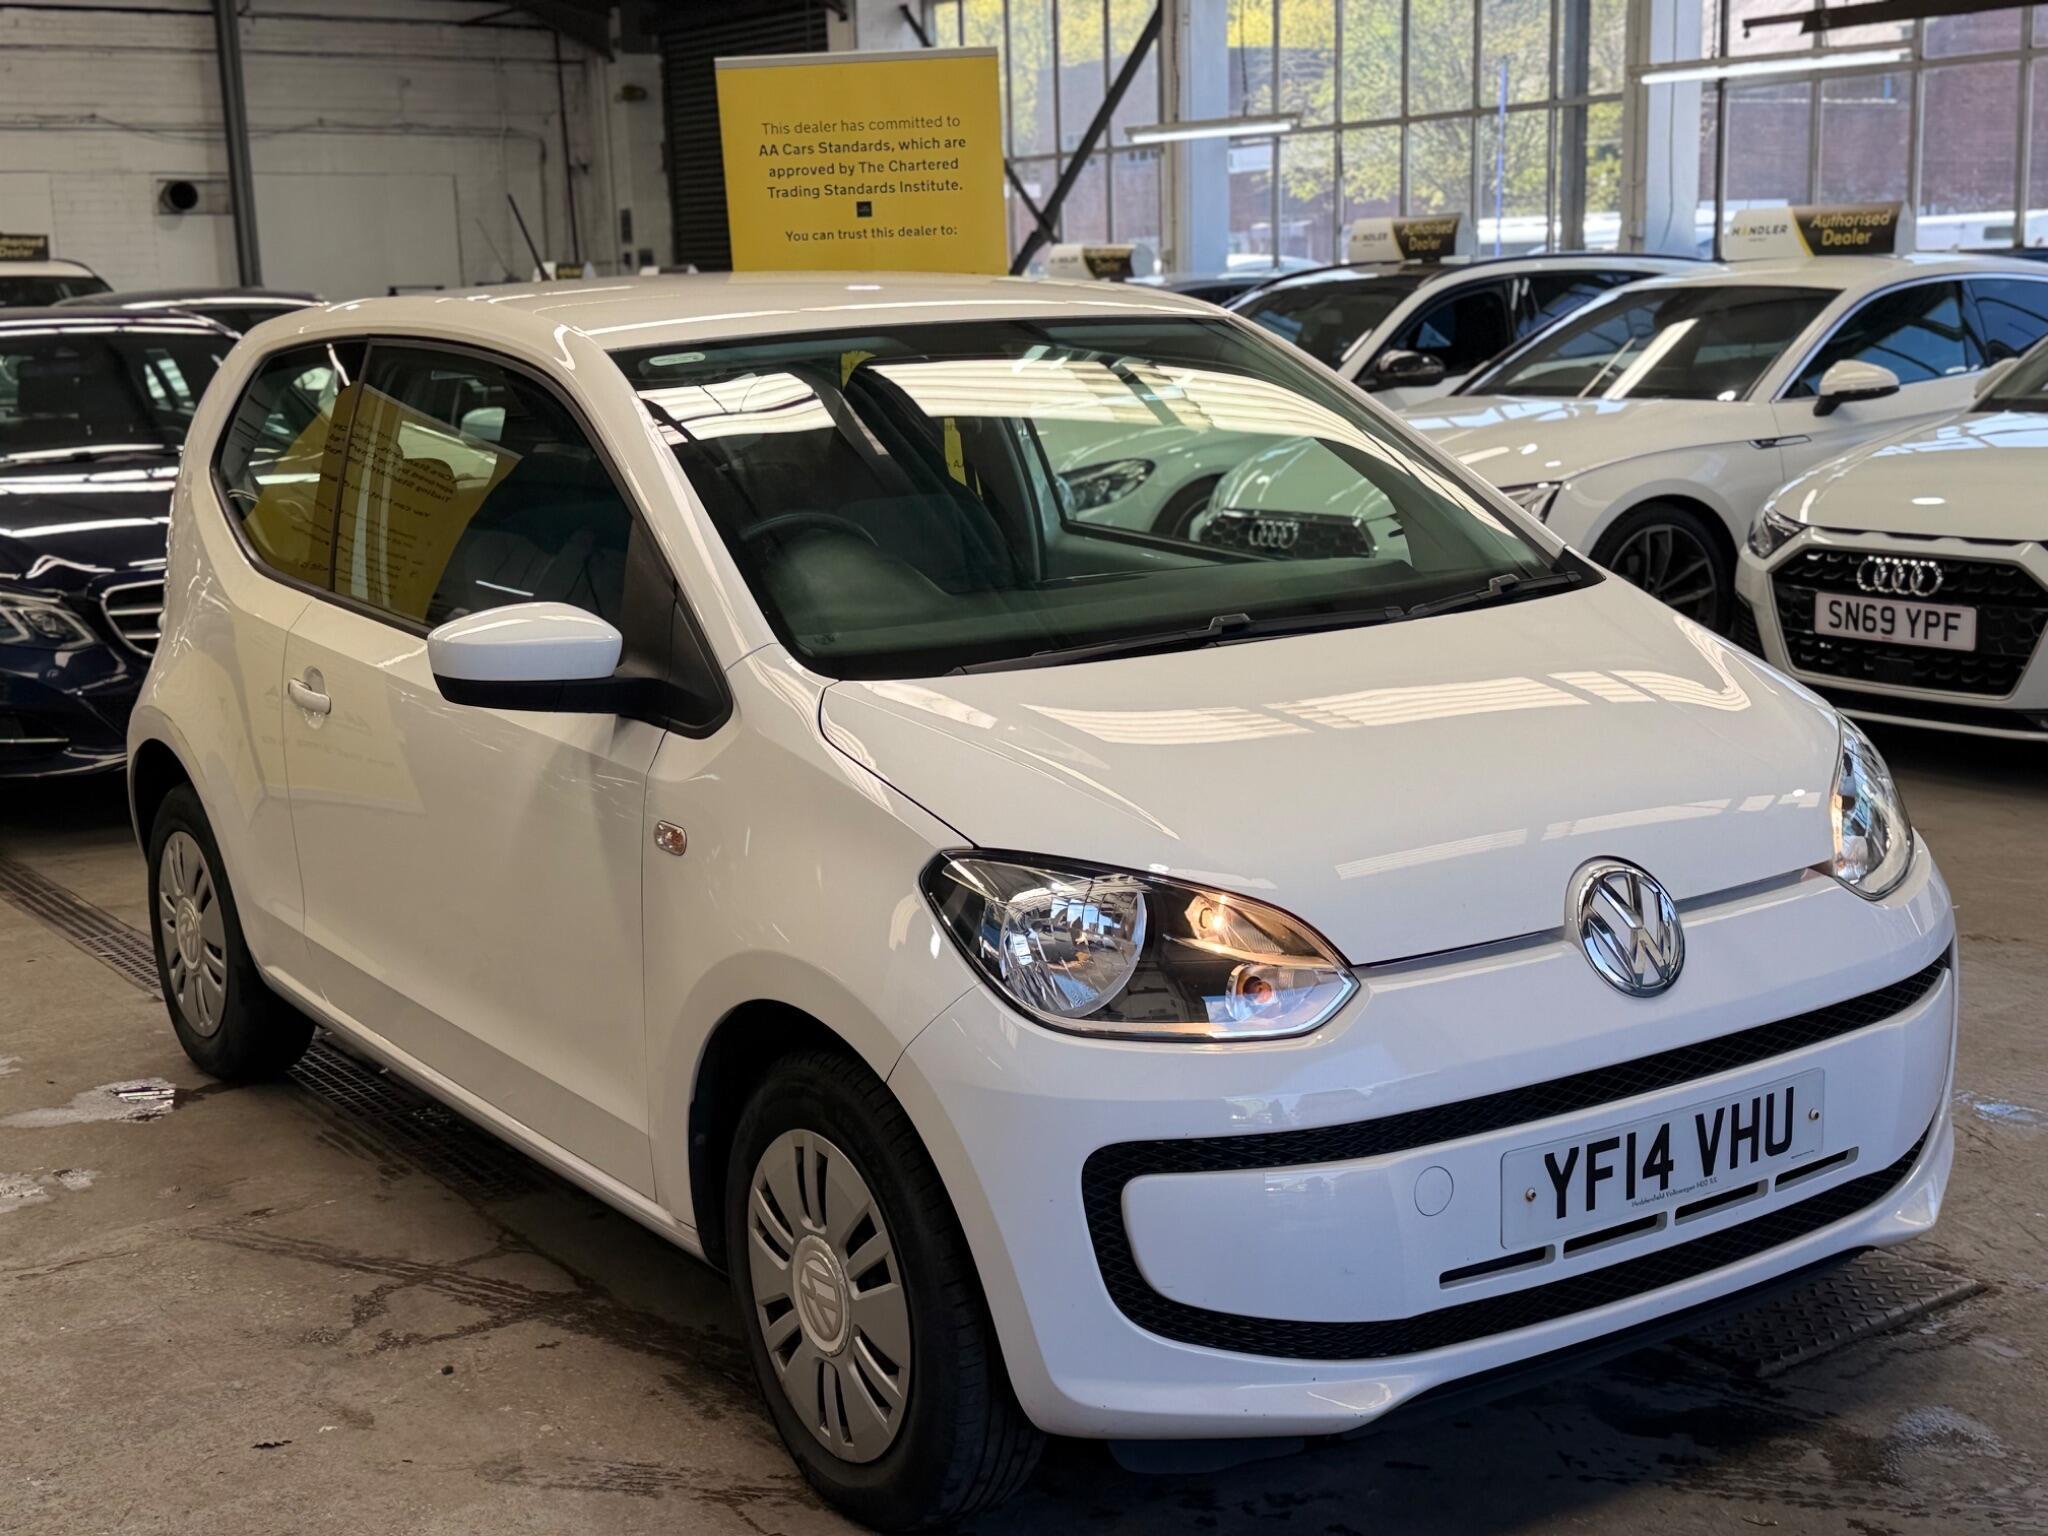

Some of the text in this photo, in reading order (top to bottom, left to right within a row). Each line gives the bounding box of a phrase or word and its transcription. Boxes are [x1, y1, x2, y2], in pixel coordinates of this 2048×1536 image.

[762, 116, 960, 135] This dealer has committed to
[759, 137, 966, 156] AA Cars Standards, which are
[769, 159, 959, 179] approved by The Chartered
[767, 180, 963, 199] Trading Standards Institute.
[1810, 210, 1892, 229] Authorised
[786, 226, 958, 242] You can trust this dealer to:
[1822, 229, 1872, 246] Dealer
[1828, 600, 1961, 641] SN69 YPF
[1544, 1086, 1794, 1219] YF14 VHU
